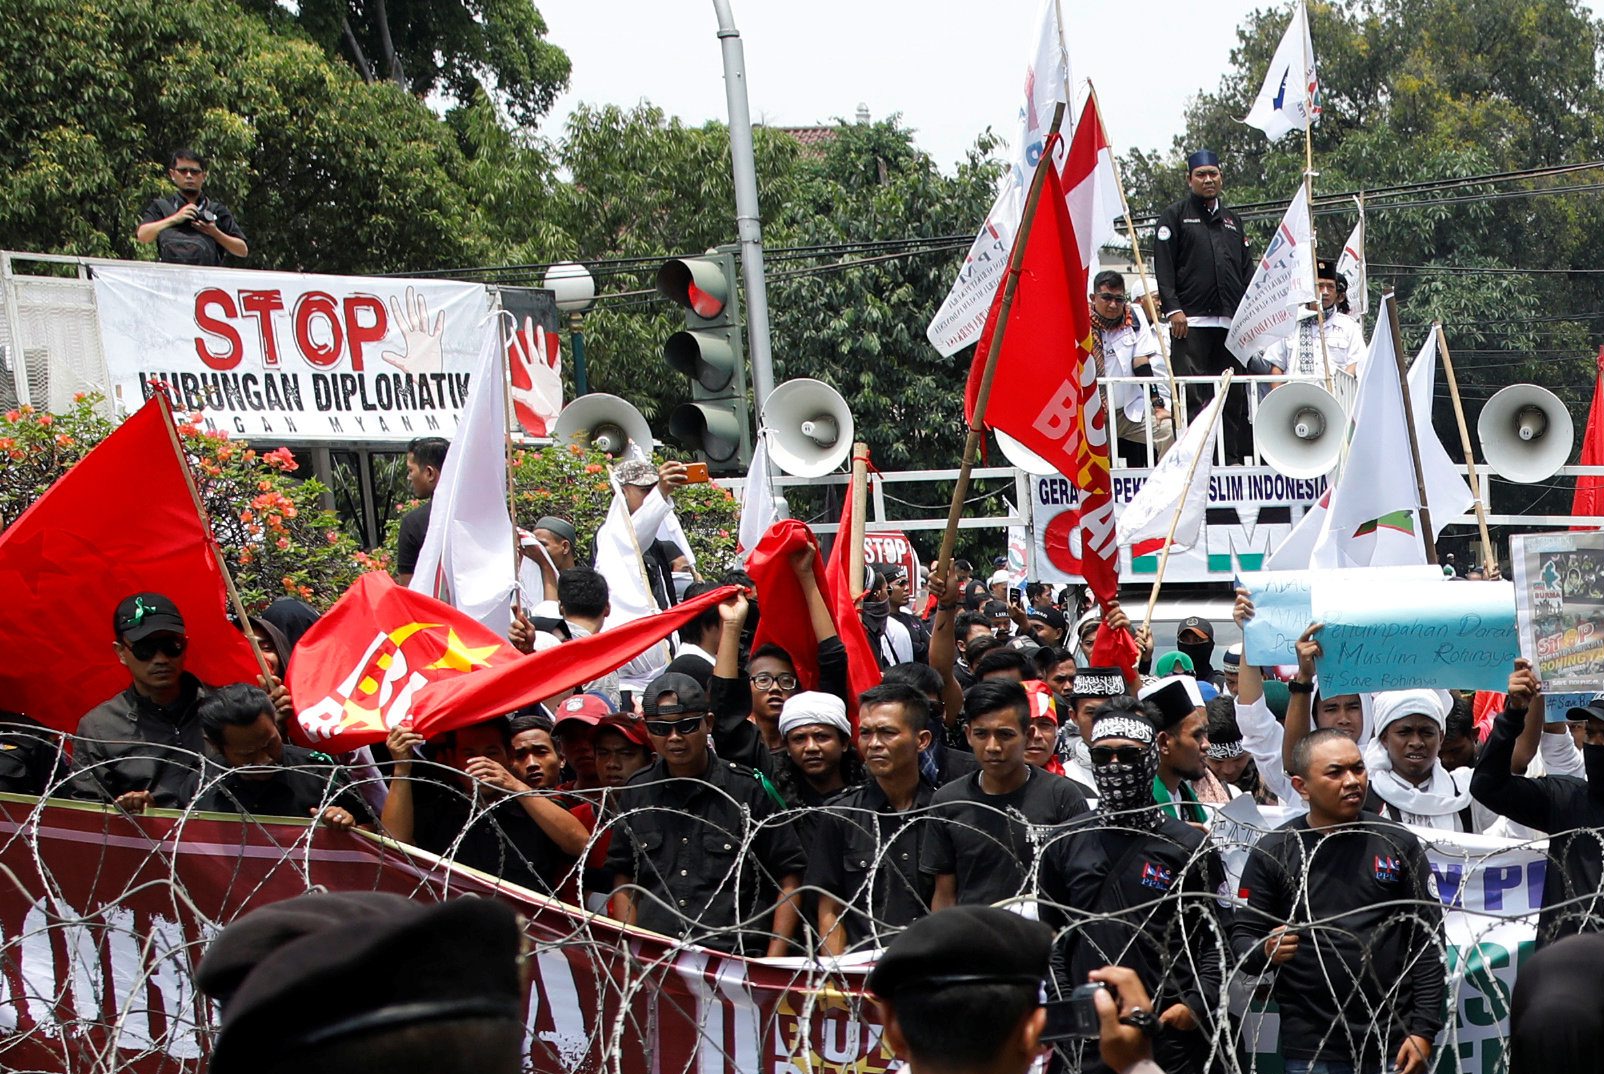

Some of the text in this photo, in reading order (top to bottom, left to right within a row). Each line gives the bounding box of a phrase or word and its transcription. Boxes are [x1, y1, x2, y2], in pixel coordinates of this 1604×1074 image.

[195, 285, 389, 373] STOP
[139, 372, 470, 412] HUBUNGAN DIPLOMATIK
[328, 414, 461, 433] MYANMA
[1039, 478, 1079, 506] GERA
[1209, 475, 1243, 501] SLIM
[1249, 474, 1328, 501] INDONESIA
[864, 540, 907, 563] STOP
[1337, 641, 1417, 665] Muslim
